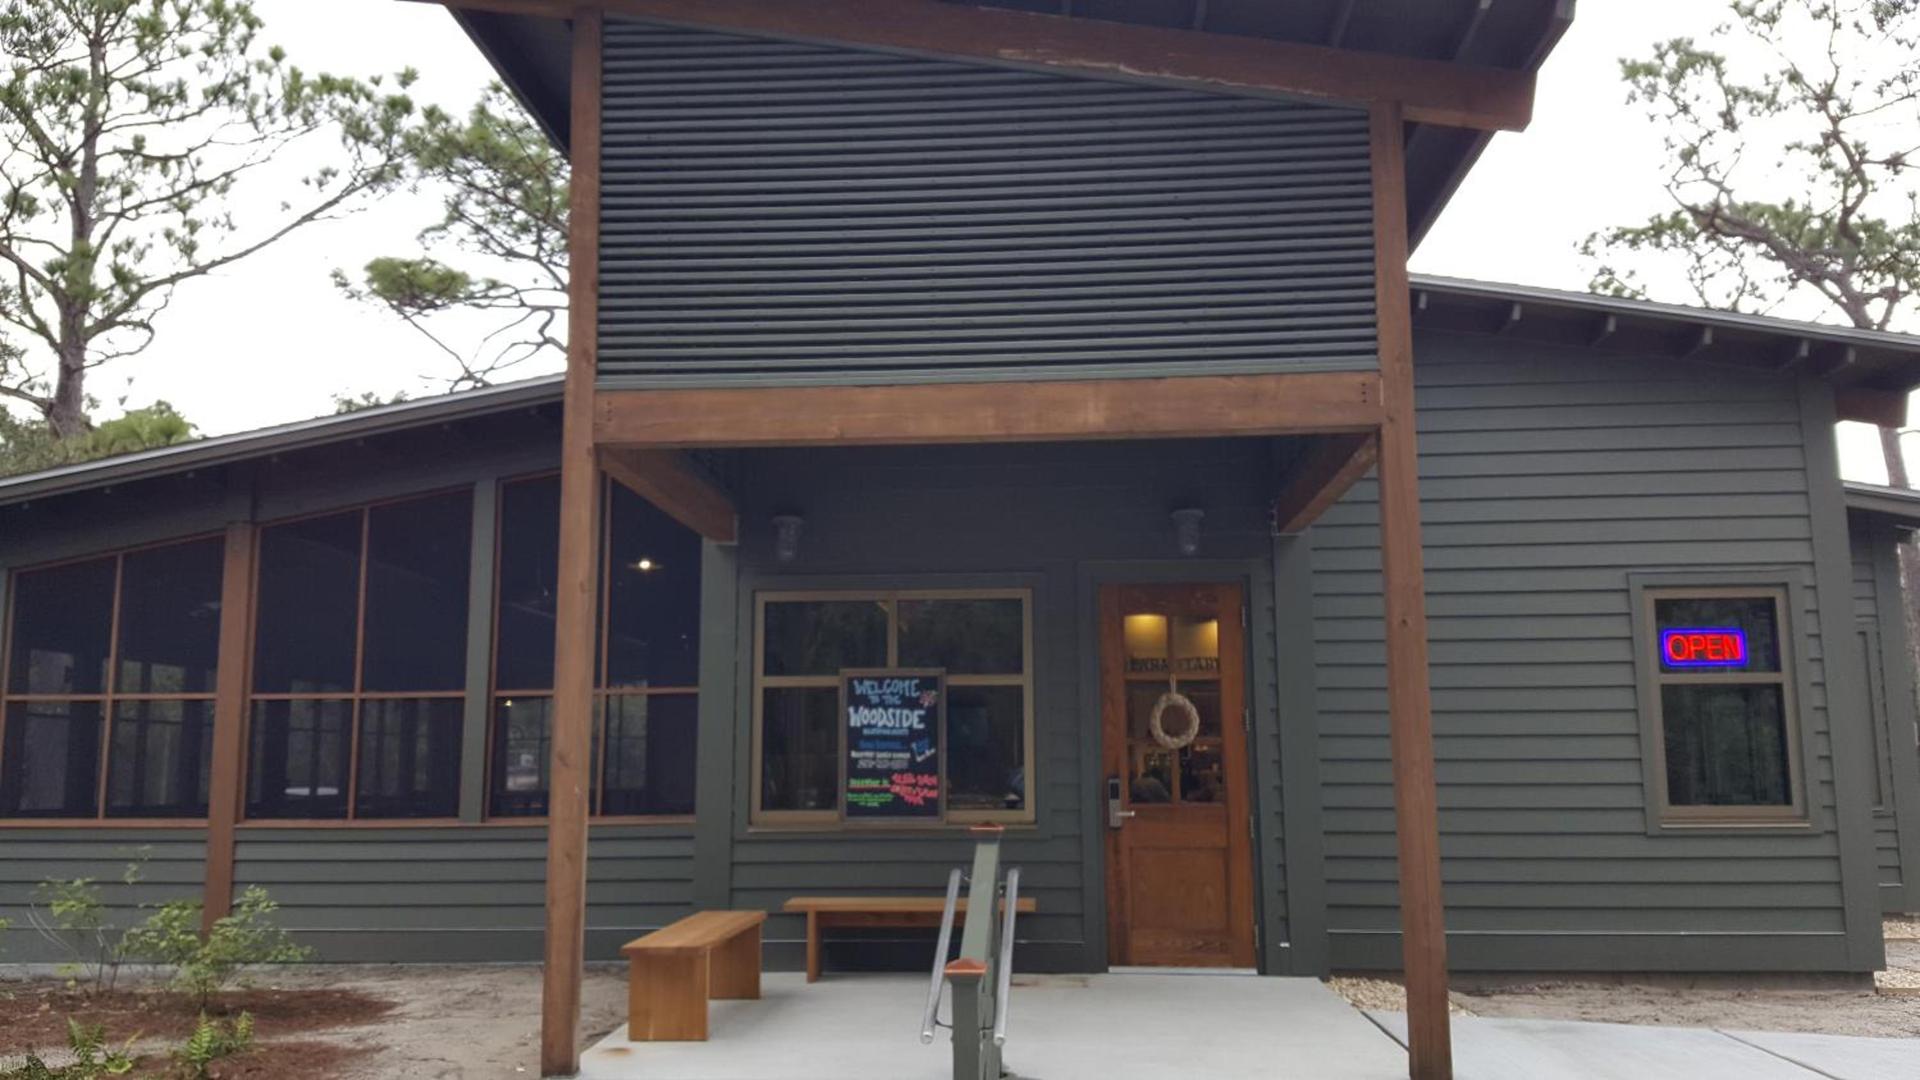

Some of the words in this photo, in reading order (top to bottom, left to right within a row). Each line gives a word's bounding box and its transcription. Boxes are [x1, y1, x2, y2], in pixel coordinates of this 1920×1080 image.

[1668, 634, 1741, 660] OPEN
[853, 678, 920, 698] WELCOME
[848, 705, 926, 729] WOODSIDE
